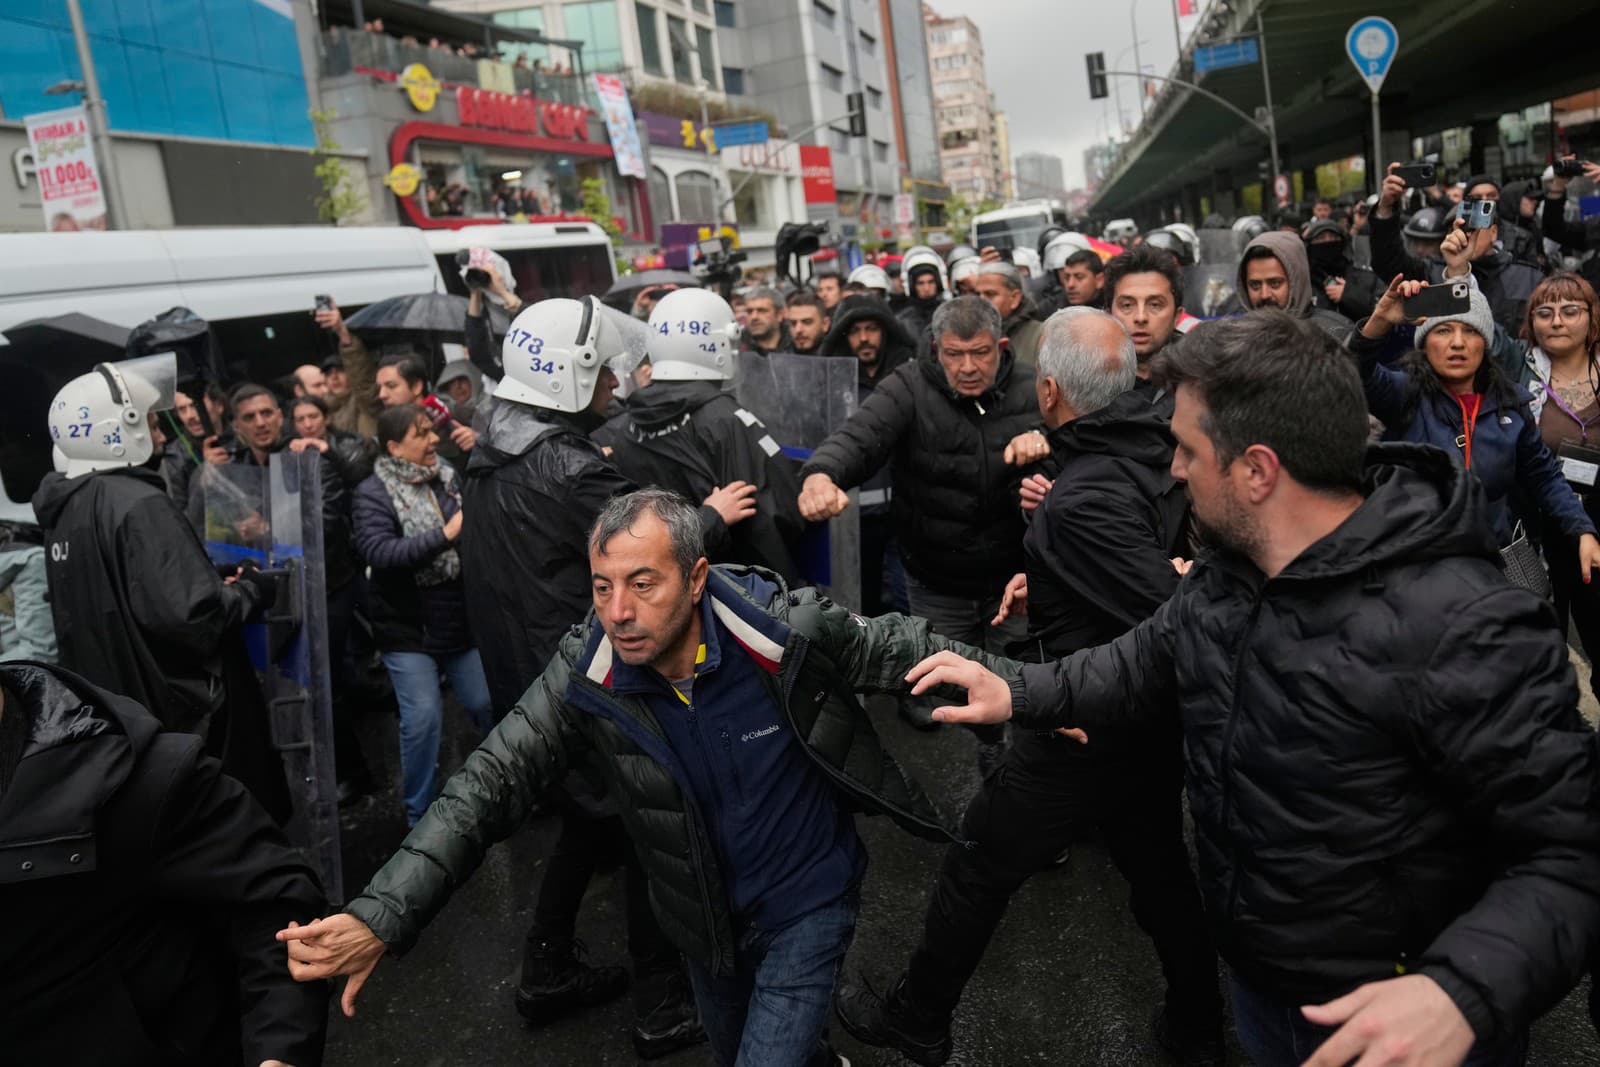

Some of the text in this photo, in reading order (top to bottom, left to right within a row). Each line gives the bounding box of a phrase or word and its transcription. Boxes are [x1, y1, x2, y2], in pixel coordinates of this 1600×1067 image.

[529, 357, 555, 375] 34
[68, 423, 93, 439] 27
[103, 434, 122, 445] 34
[748, 724, 780, 740] Columbia
